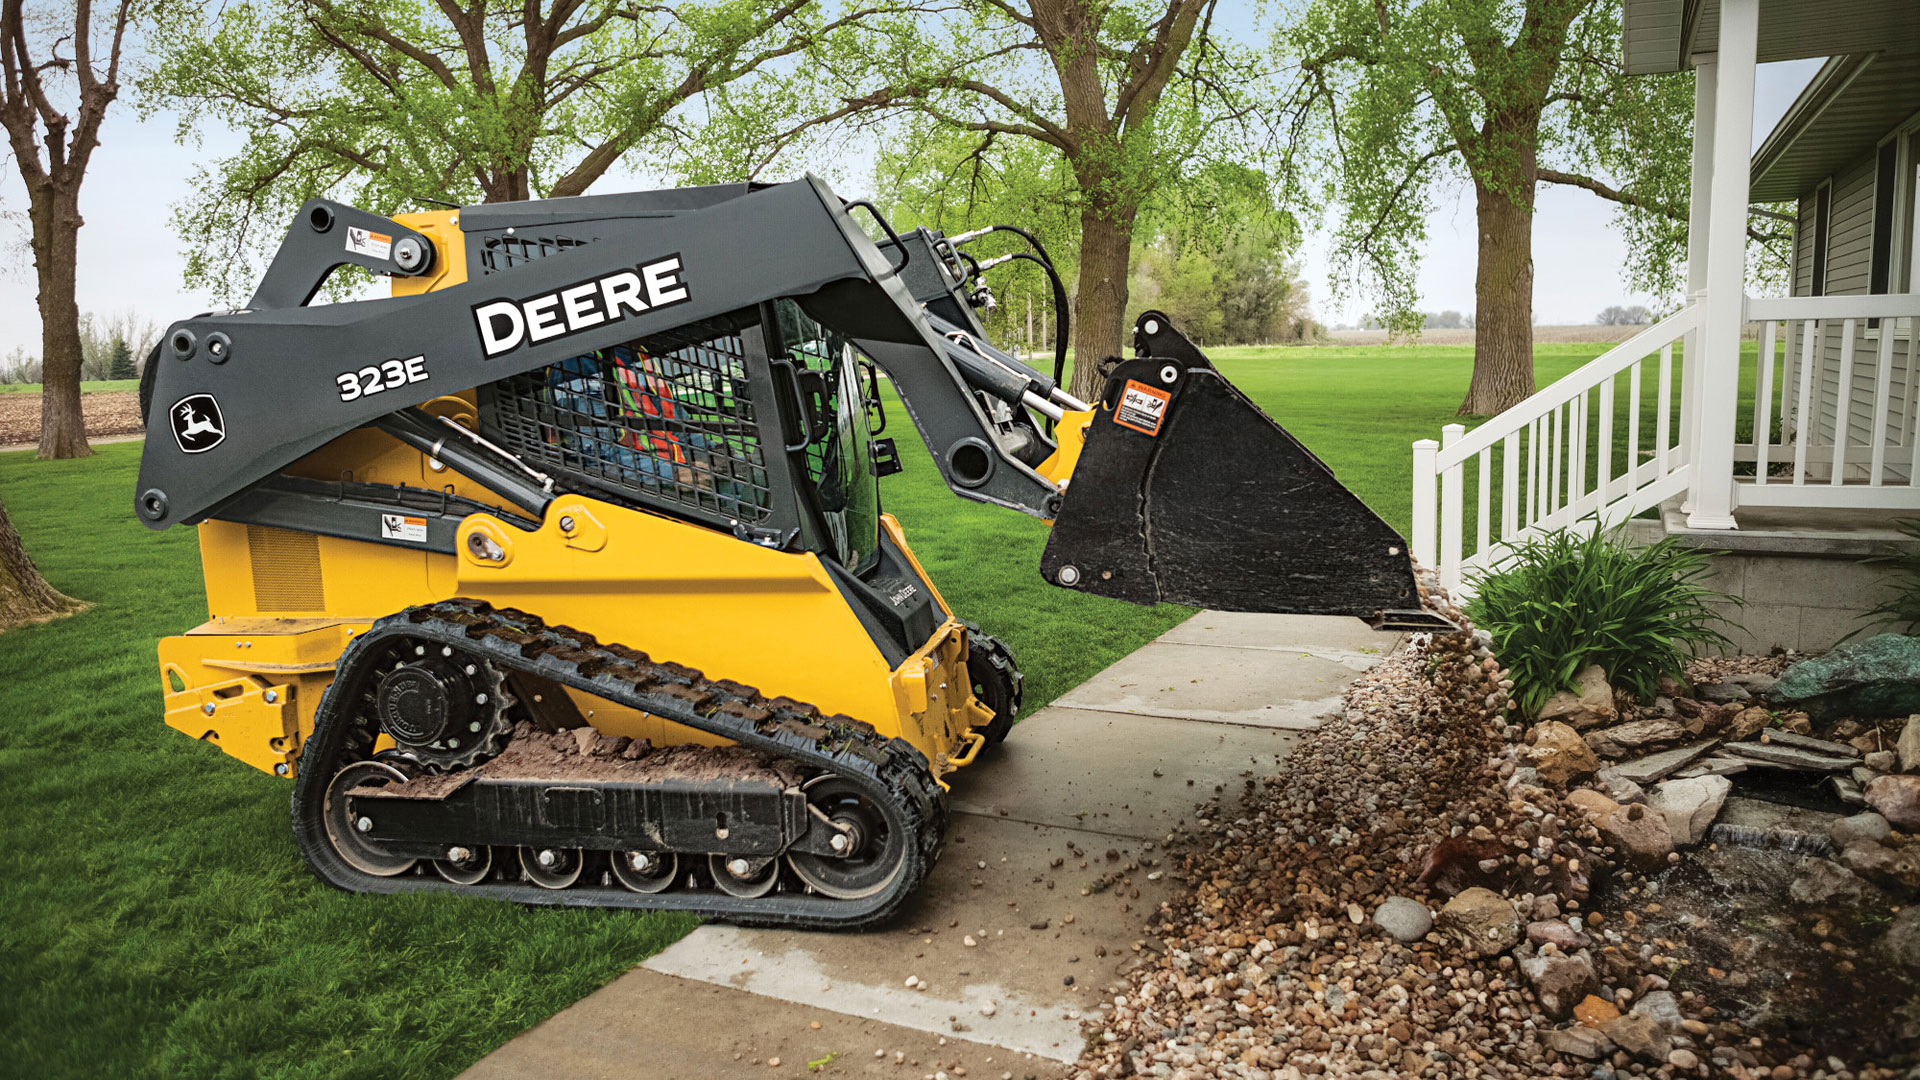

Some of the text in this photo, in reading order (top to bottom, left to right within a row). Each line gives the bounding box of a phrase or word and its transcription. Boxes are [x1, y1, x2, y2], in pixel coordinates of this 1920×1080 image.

[475, 257, 688, 356] DEERE
[336, 355, 429, 401] 323E
[898, 584, 917, 599] DEERE
